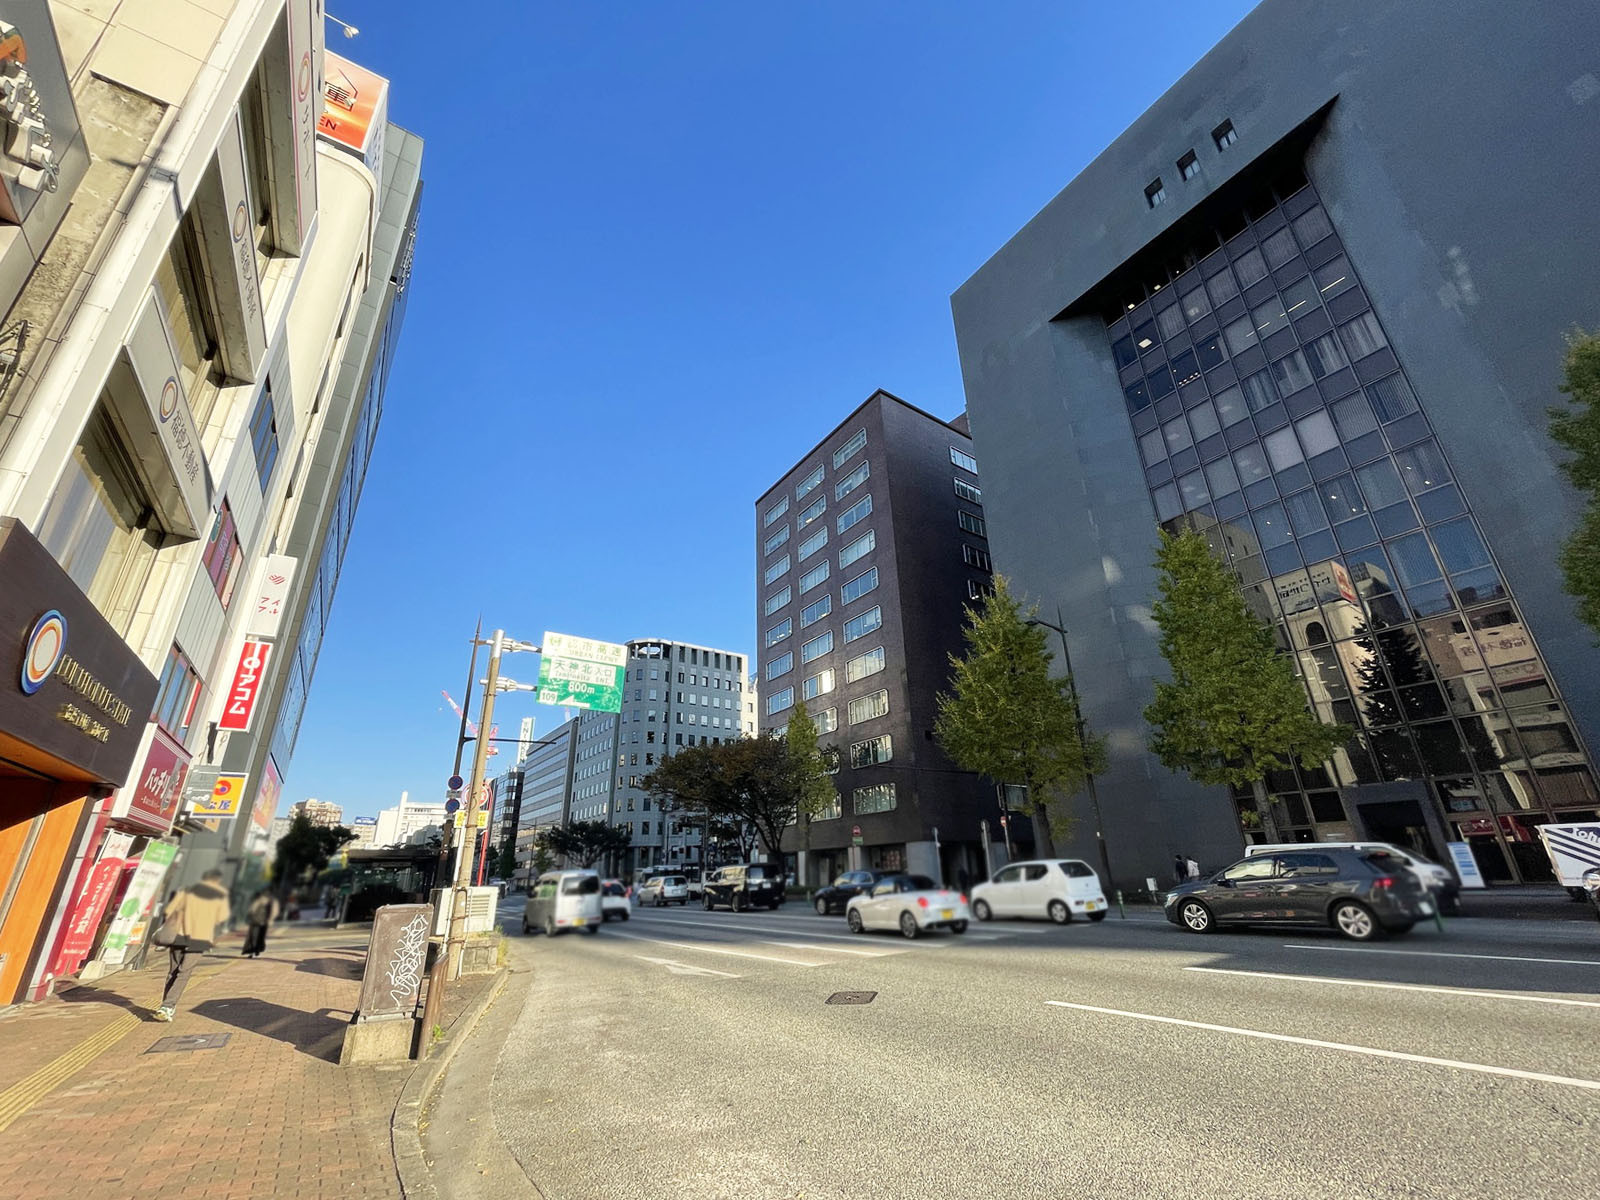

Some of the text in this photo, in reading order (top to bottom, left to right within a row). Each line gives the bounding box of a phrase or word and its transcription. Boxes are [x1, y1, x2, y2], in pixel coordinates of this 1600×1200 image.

[554, 661, 612, 678] 天神北入口
[229, 673, 257, 715] アコム
[568, 681, 595, 694] 800m
